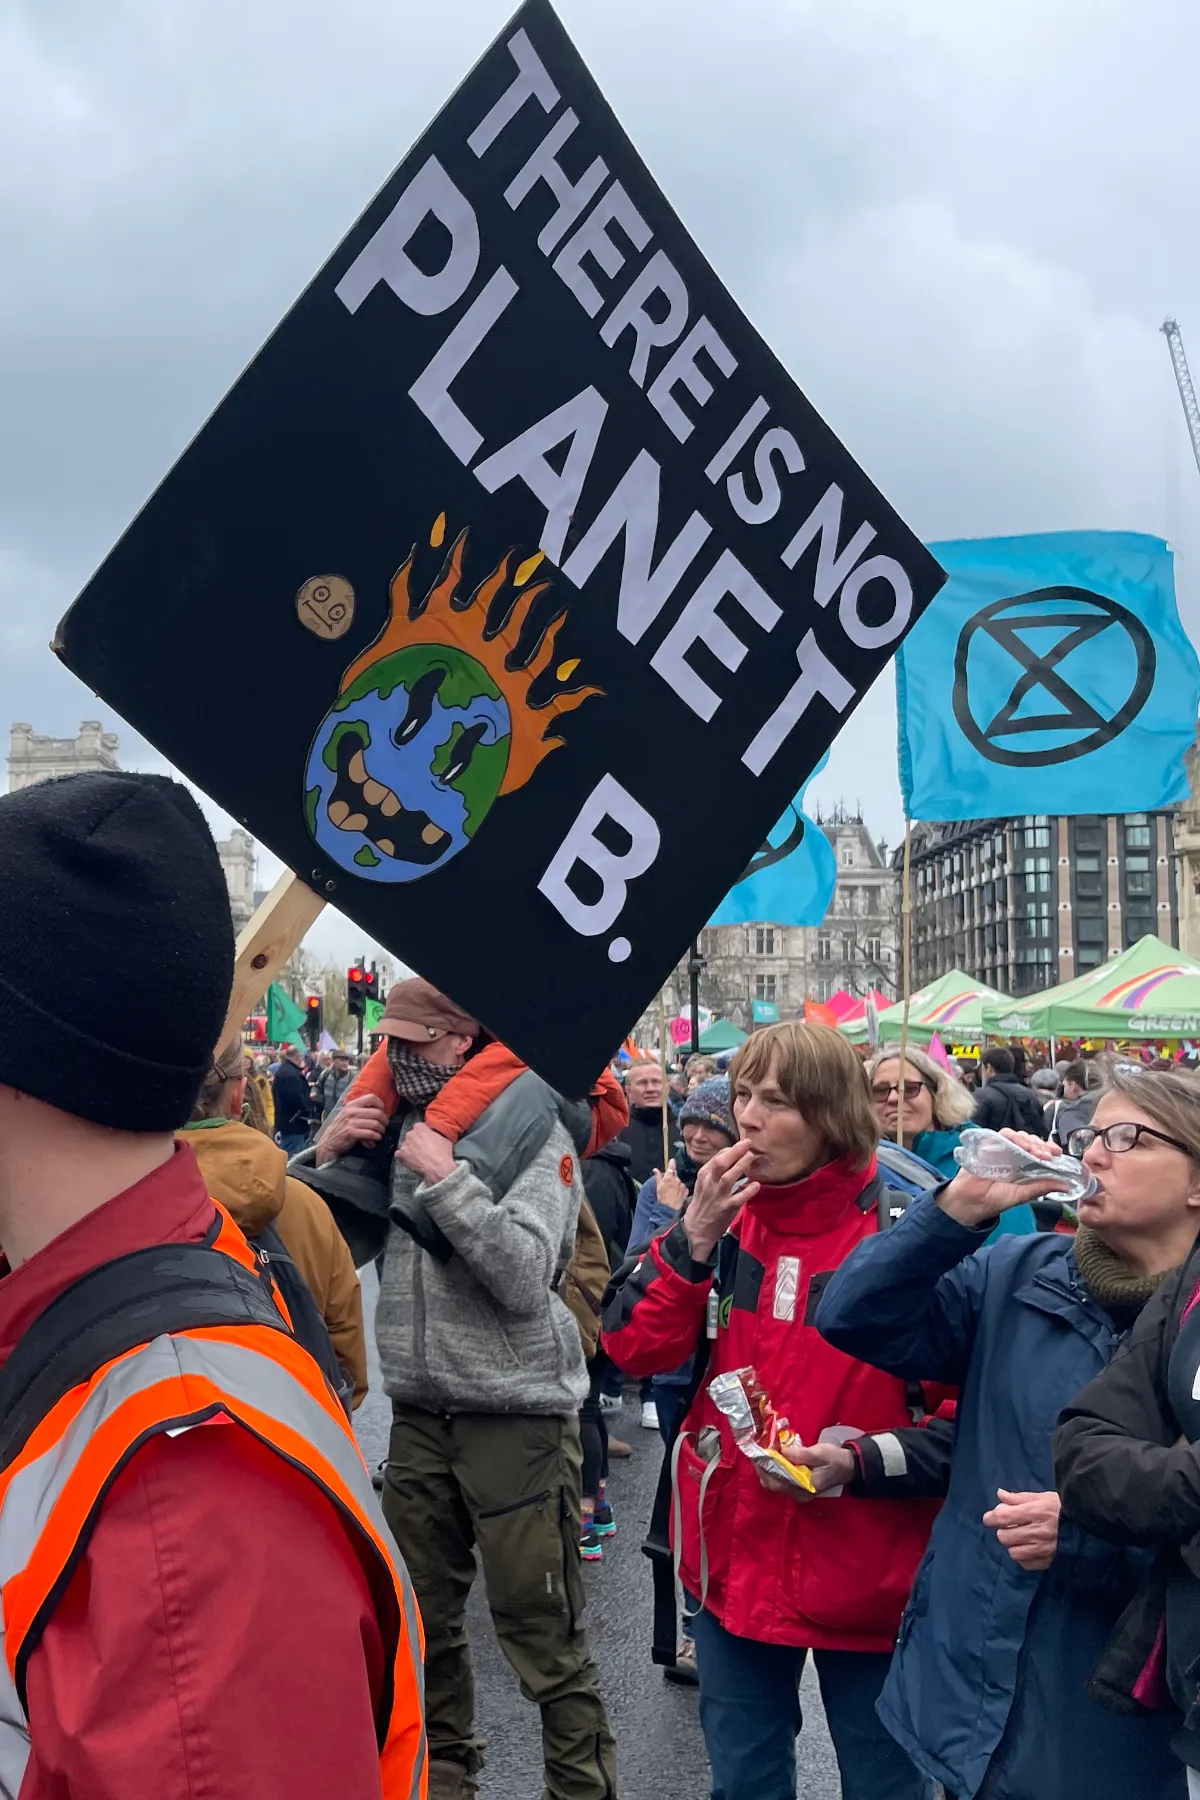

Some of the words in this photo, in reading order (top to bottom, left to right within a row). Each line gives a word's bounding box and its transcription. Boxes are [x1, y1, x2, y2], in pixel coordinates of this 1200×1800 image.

[335, 154, 856, 777] PLANET
[467, 28, 738, 444] THERE
[705, 396, 805, 524] IS
[781, 482, 913, 649] NO
[537, 773, 660, 963] B.
[1128, 1013, 1200, 1033] GREEN
